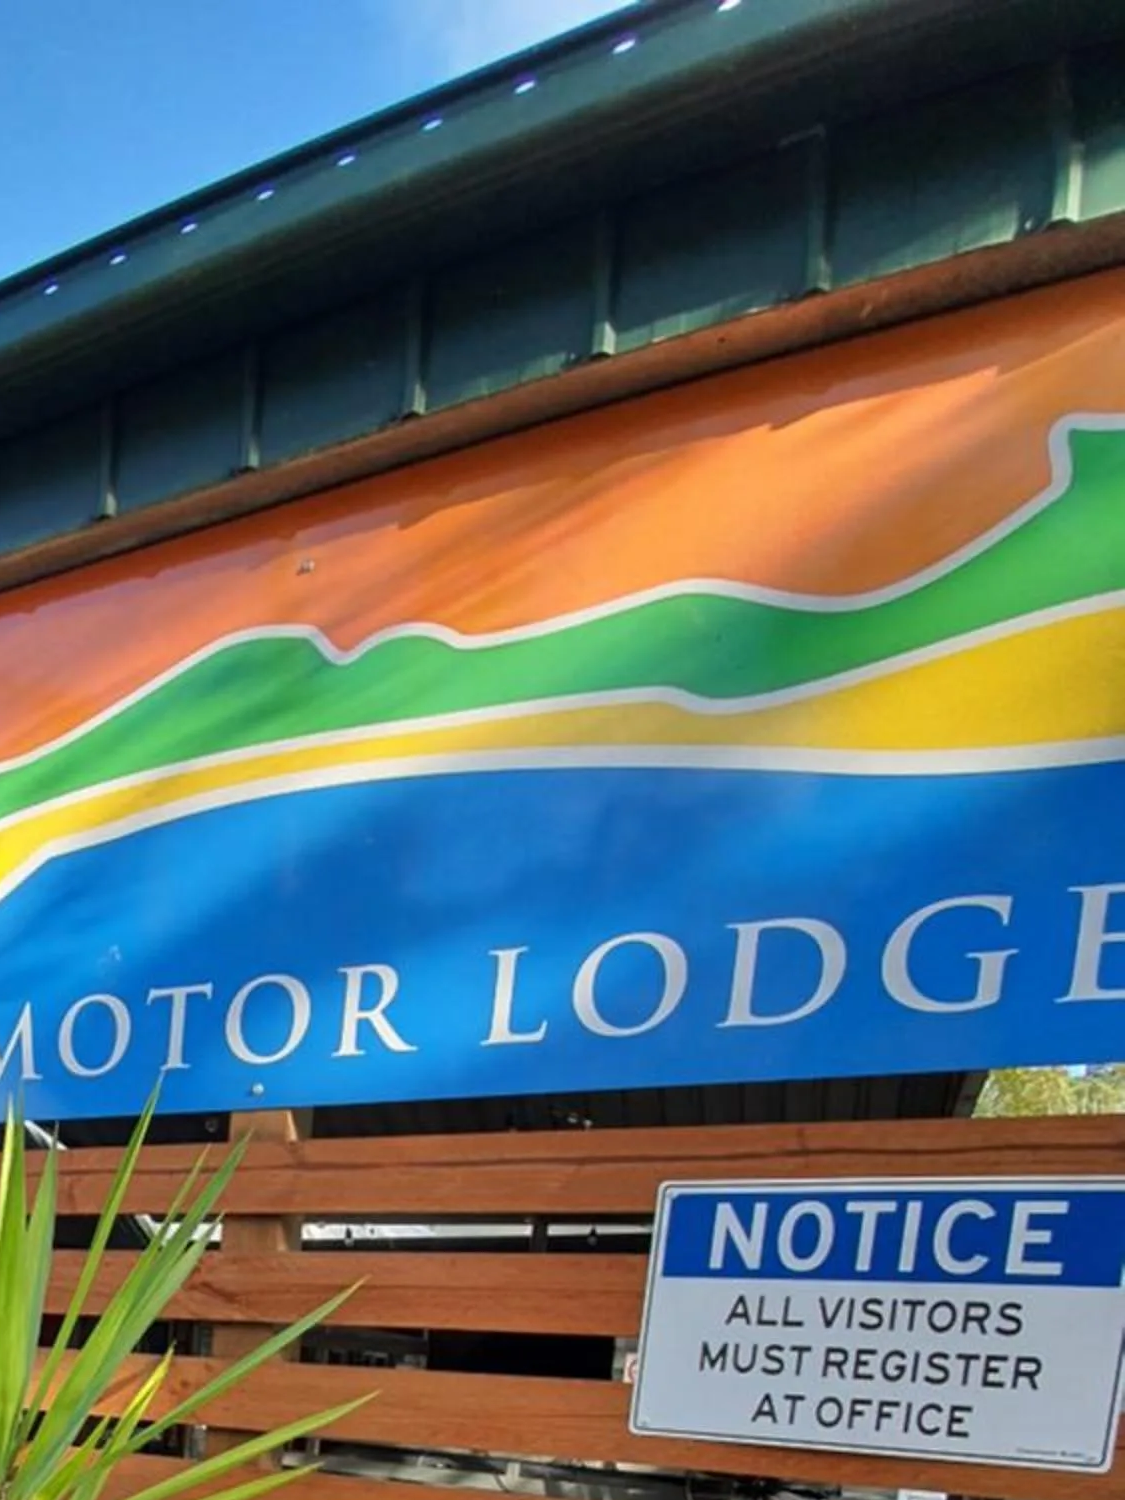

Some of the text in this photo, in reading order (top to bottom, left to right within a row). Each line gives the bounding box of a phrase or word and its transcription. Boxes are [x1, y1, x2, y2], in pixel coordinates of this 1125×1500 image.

[480, 880, 1125, 1046] LODGE
[708, 1199, 1071, 1277] NOTICE
[724, 1294, 1024, 1336] ALL VISITORS
[697, 1341, 1043, 1390] MUST REGISTER
[750, 1393, 974, 1439] AT OFFICE
